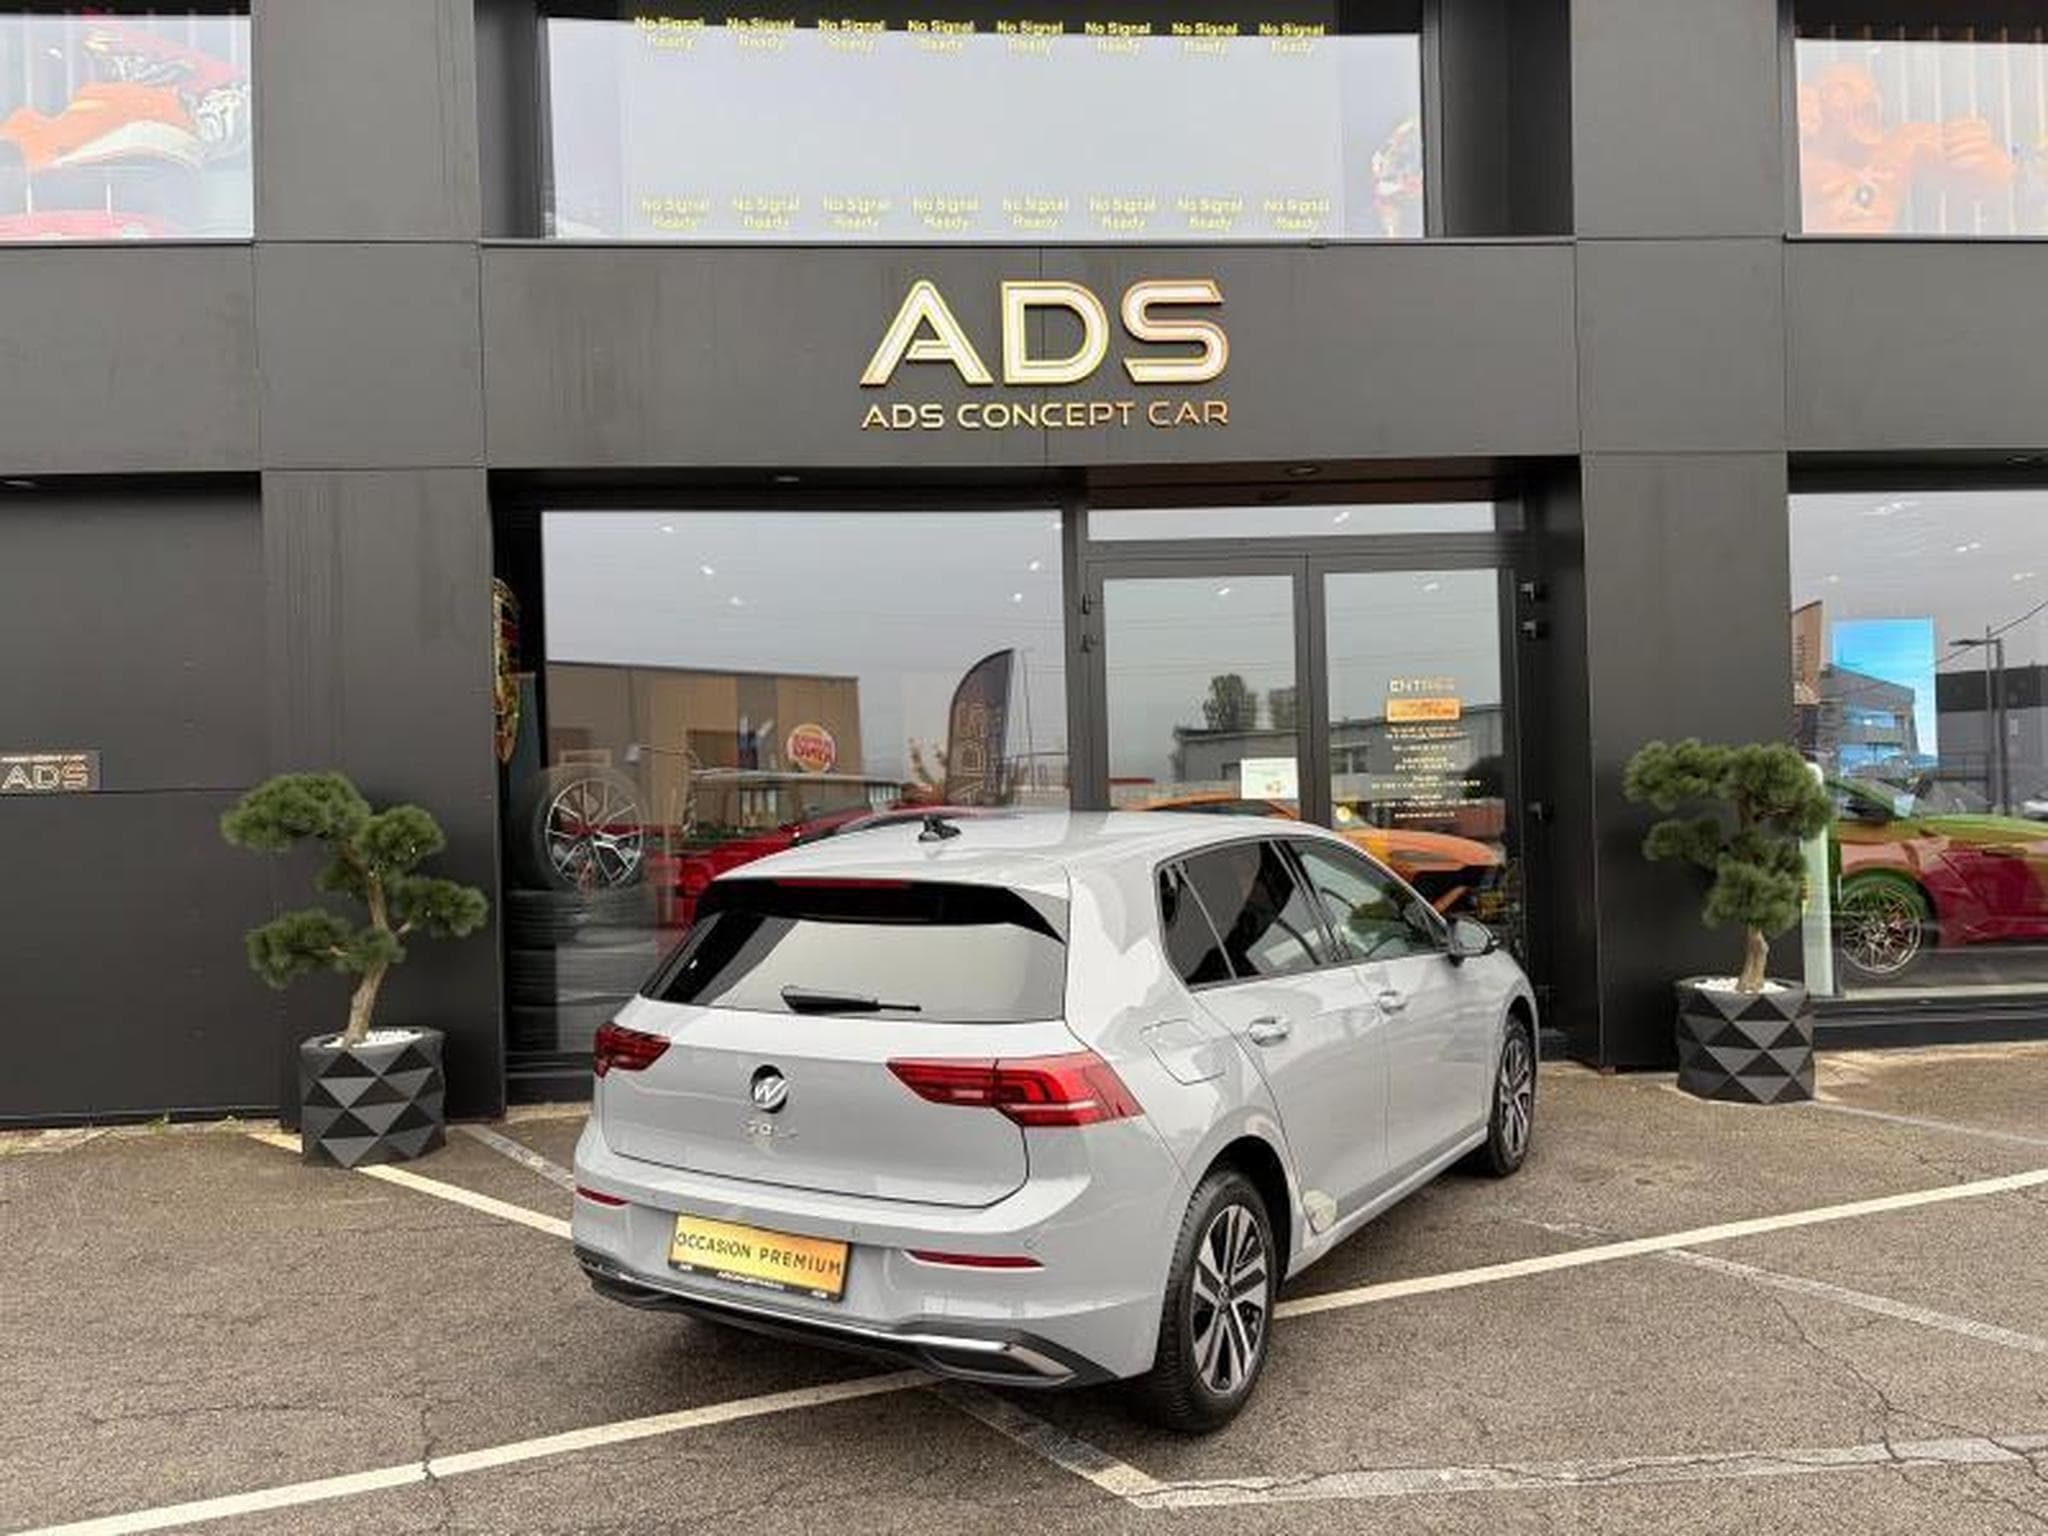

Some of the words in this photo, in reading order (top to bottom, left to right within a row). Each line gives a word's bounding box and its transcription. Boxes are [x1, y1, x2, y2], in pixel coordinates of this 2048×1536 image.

[635, 17, 655, 31] No
[727, 18, 747, 32] No
[818, 19, 839, 32] No
[908, 20, 929, 33] No
[997, 21, 1019, 34] No
[1085, 22, 1107, 35] No
[1172, 23, 1194, 35] No
[1259, 23, 1280, 36] No
[859, 279, 1231, 386] ADS
[860, 403, 945, 430] ADS
[956, 401, 1135, 429] CONCEPT
[1146, 400, 1230, 426] CAR
[1, 764, 89, 790] ADS
[674, 1231, 752, 1259] OCCASION
[759, 1247, 842, 1276] PREMIUM
